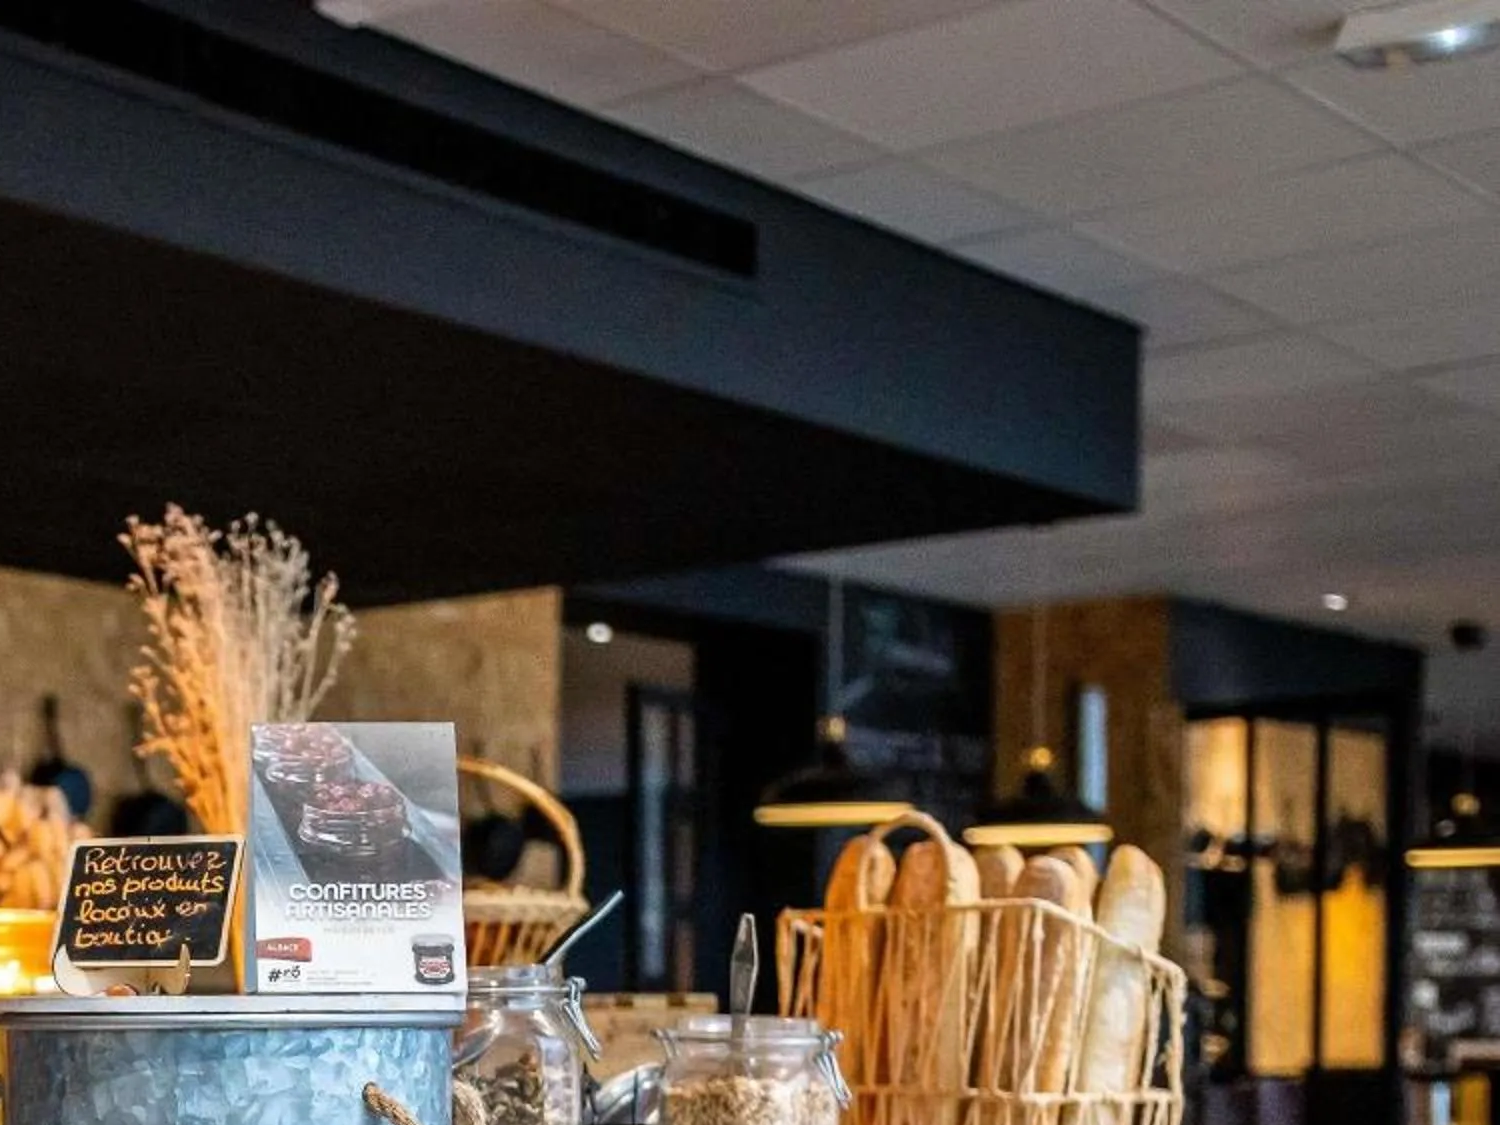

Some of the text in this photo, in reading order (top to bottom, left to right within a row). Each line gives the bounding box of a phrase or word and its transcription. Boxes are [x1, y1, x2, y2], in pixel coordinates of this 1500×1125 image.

[84, 847, 227, 875] Retrouvez
[74, 871, 225, 901] nos produits
[288, 882, 428, 901] CONFITURES
[75, 899, 167, 924] locaux
[284, 901, 433, 920] ARTISANALES
